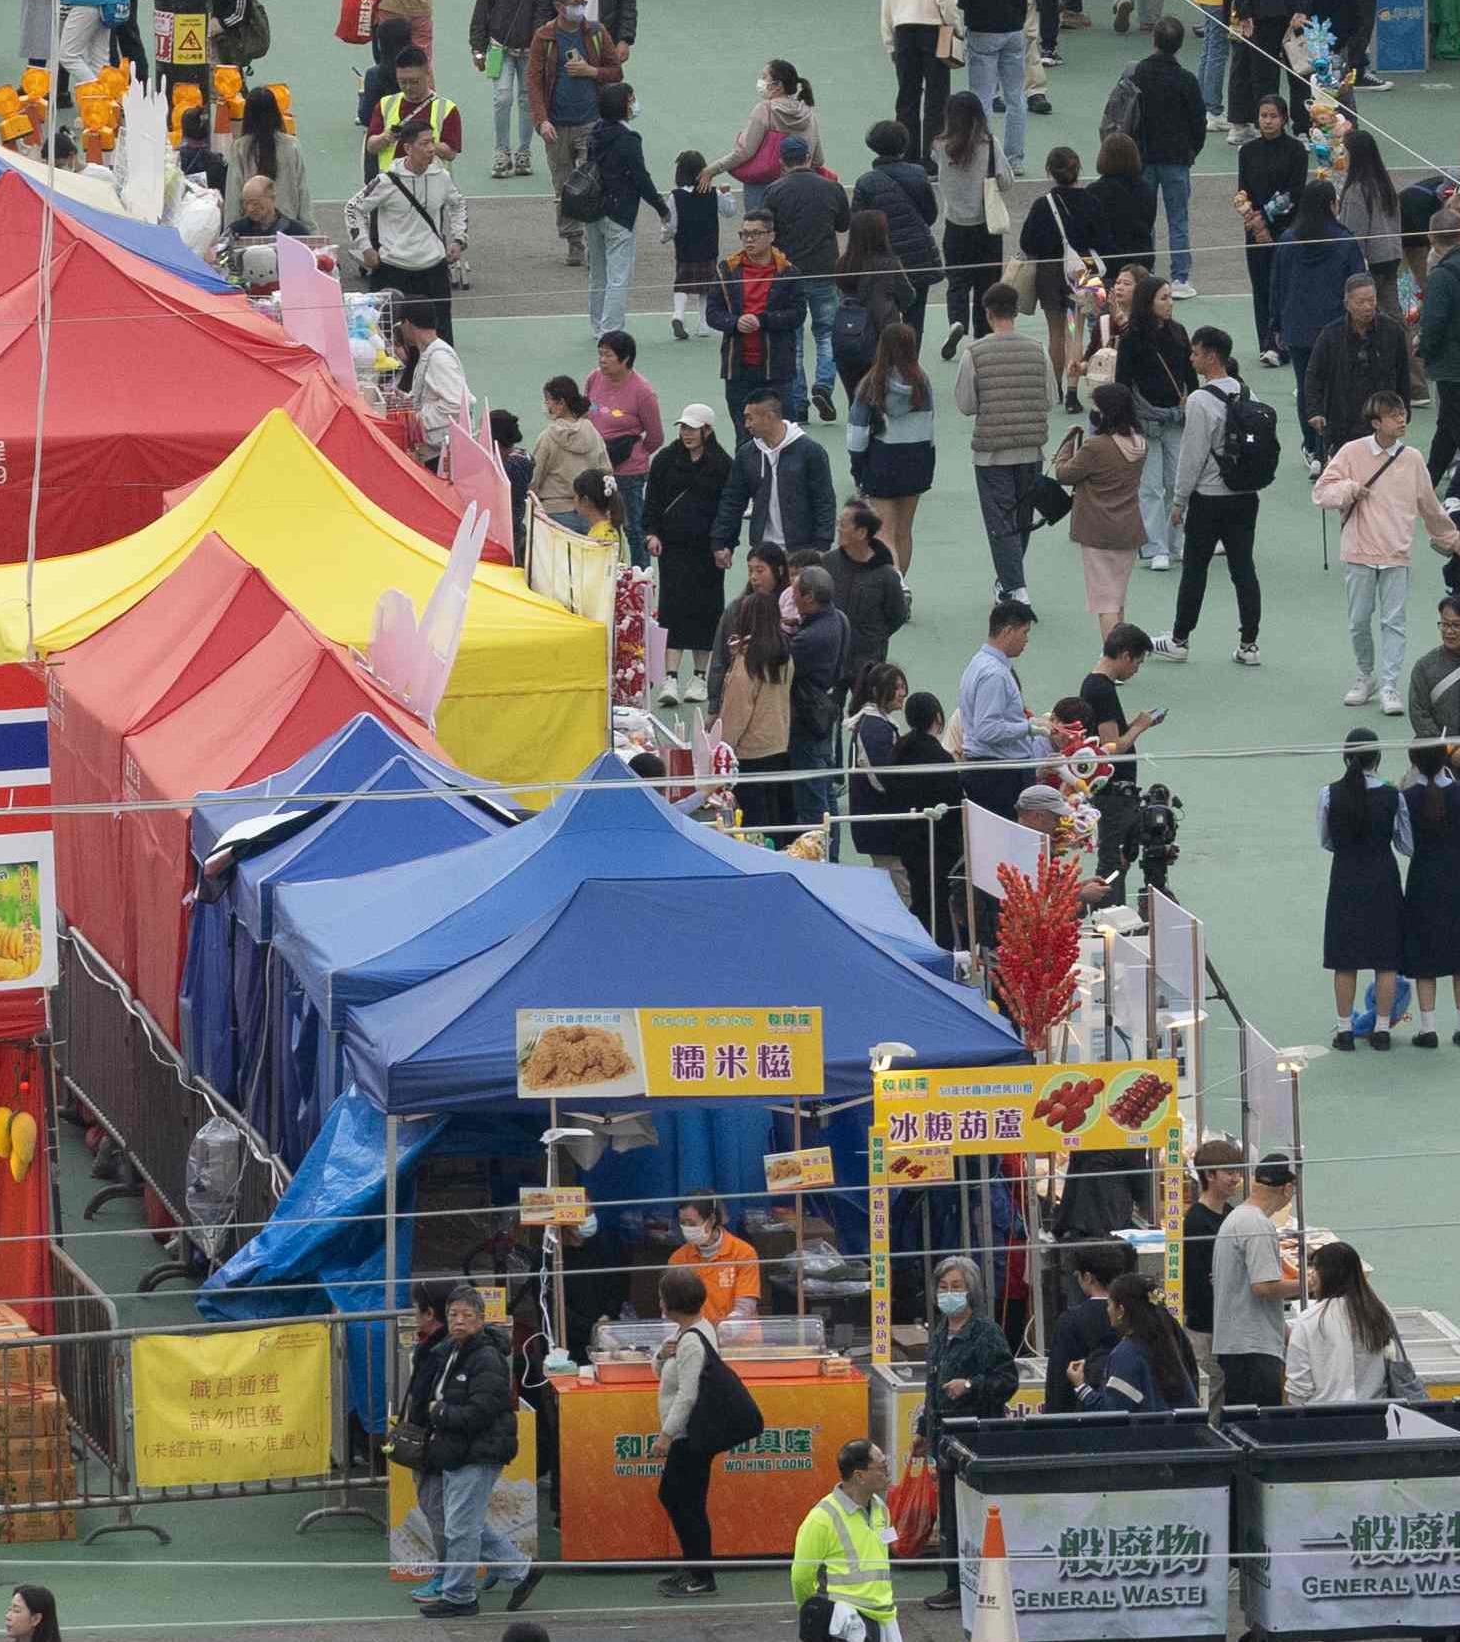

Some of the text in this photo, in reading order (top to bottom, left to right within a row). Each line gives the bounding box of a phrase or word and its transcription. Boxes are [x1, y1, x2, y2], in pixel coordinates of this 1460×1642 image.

[670, 1044, 792, 1080] 糯米糍
[889, 1109, 1024, 1144] 冰糖葫蘆
[190, 1373, 281, 1401] 職員通道
[190, 1405, 284, 1432] 請勿阻塞
[615, 1465, 634, 1475] WO
[724, 1458, 812, 1471] WO HING LOONG
[1008, 1524, 1209, 1578] 一般廢物
[1123, 1585, 1202, 1606] WASTE
[1301, 1576, 1408, 1596] GENERAL
